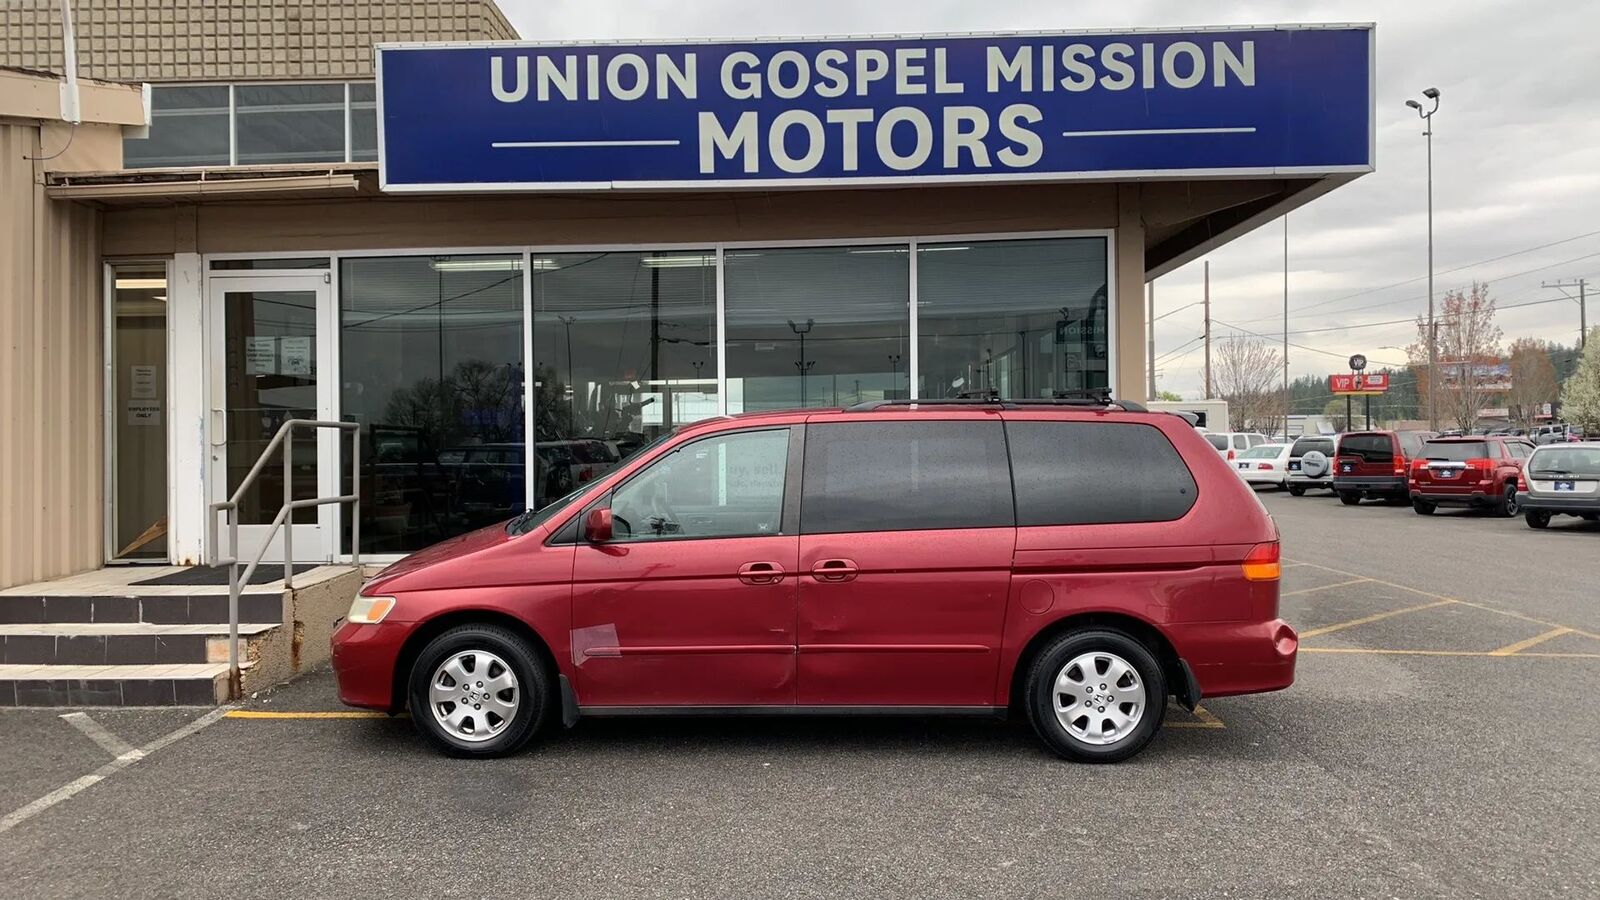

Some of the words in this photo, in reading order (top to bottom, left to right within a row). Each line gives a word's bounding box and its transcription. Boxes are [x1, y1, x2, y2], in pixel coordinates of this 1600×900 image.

[490, 53, 698, 103] UNION
[720, 47, 965, 99] GOSPEL
[986, 41, 1256, 93] MISSION
[698, 104, 1044, 174] MOTORS
[1336, 378, 1350, 388] VIP
